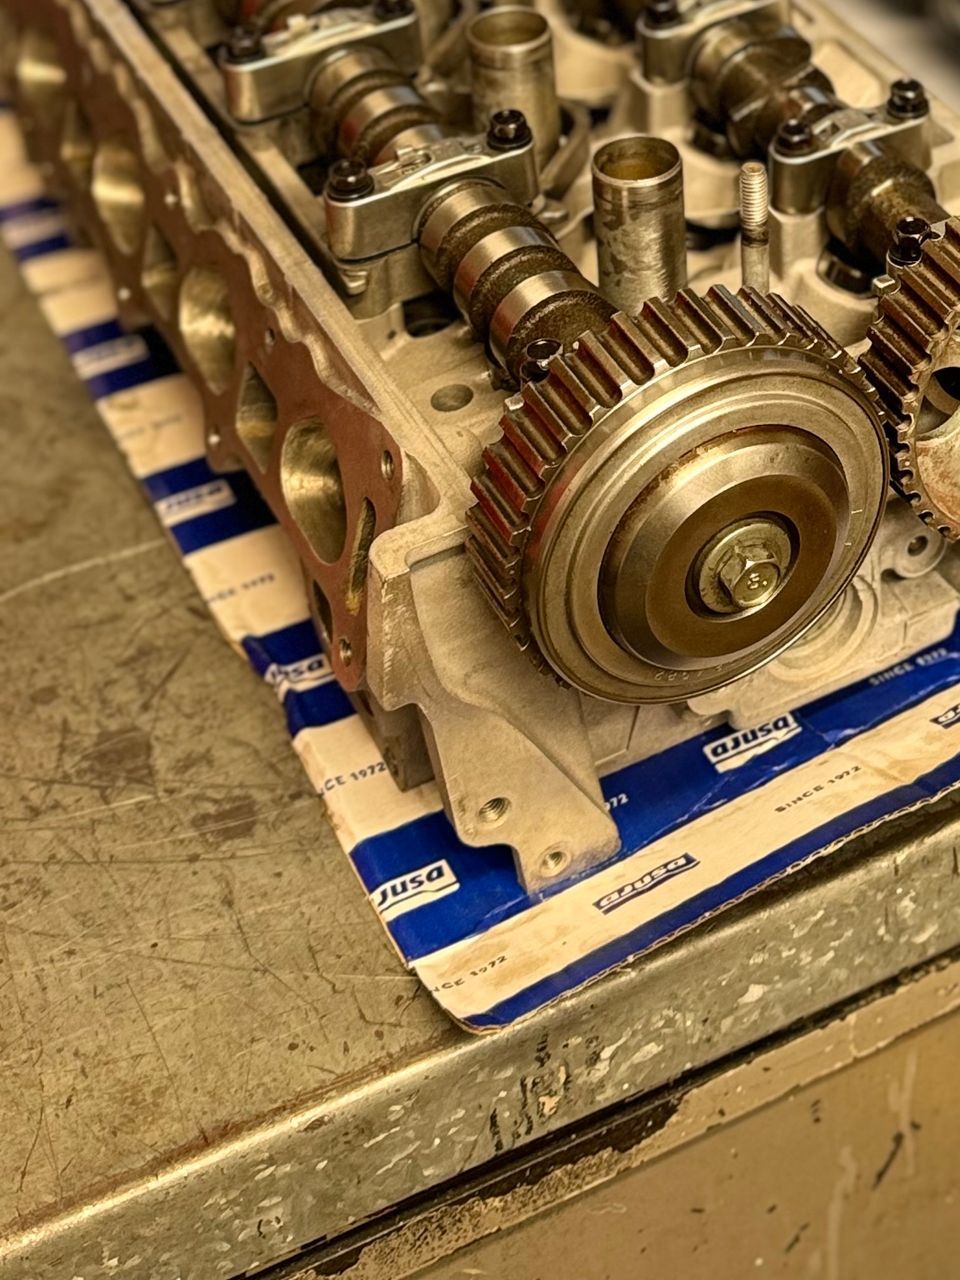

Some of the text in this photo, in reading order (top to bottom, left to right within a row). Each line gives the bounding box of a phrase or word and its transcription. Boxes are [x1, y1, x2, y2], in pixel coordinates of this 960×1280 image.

[710, 715, 791, 758] ajusa
[349, 760, 386, 782] 1972
[774, 783, 825, 813] SINCE
[371, 864, 445, 908] jusa
